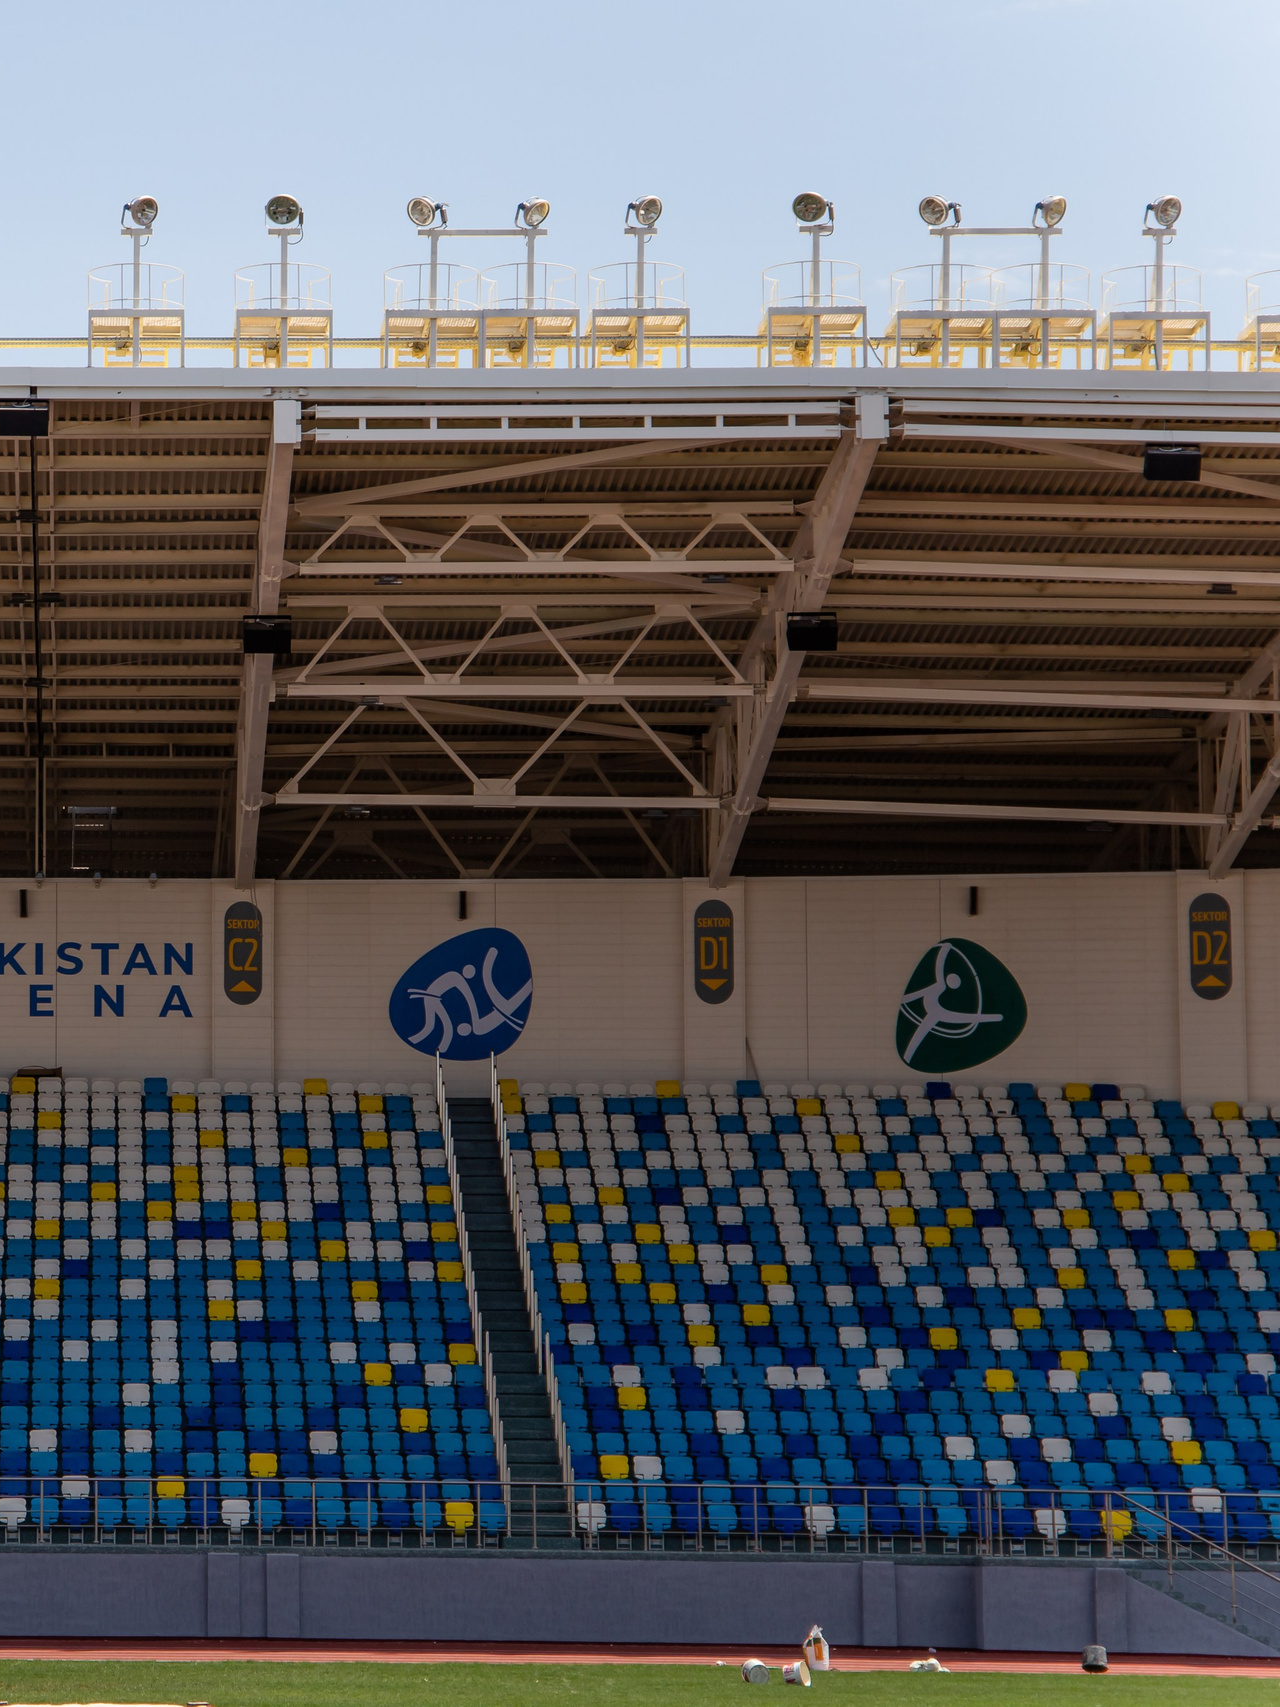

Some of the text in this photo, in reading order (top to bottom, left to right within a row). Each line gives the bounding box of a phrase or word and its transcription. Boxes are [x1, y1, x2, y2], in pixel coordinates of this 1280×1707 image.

[697, 917, 731, 928] SEKTOR
[1191, 911, 1228, 922] SEKTOR
[227, 937, 258, 971] C2
[699, 936, 728, 970] D1
[1192, 930, 1228, 965] D2
